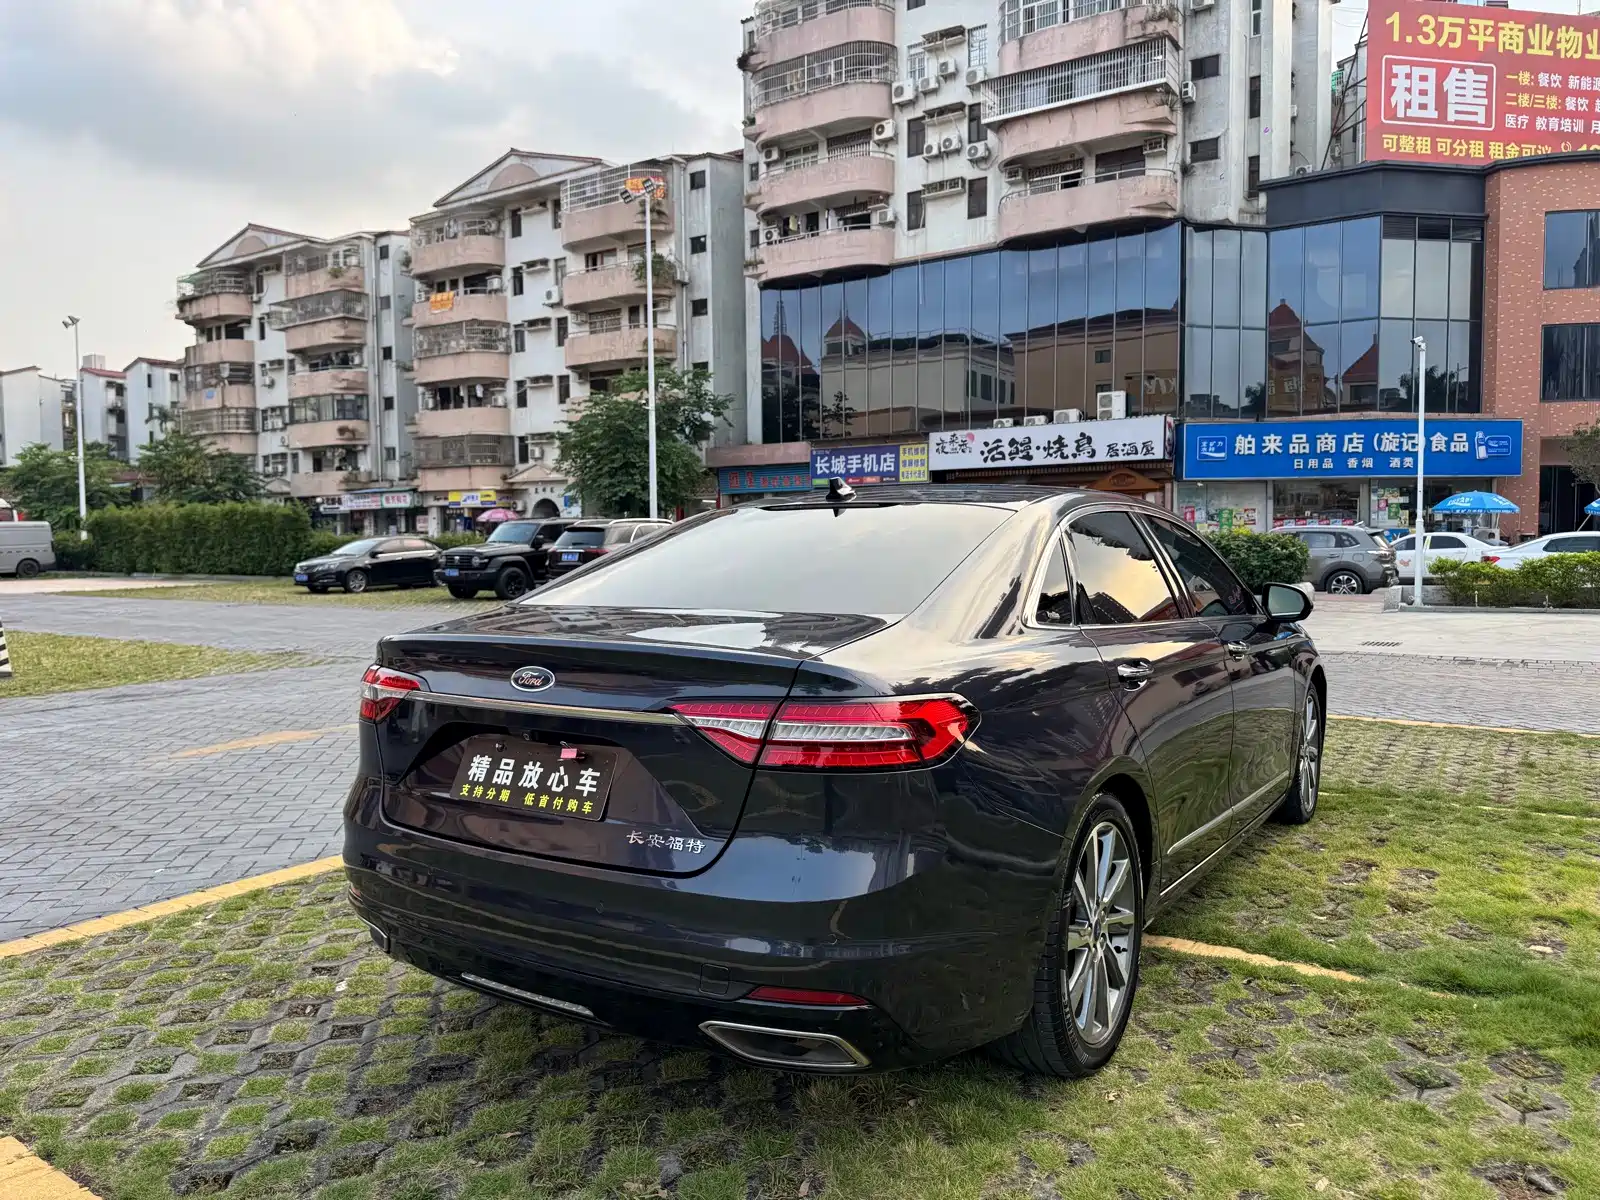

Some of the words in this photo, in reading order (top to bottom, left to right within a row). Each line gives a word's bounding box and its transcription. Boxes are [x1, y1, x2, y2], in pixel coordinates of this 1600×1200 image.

[1386, 12, 1600, 60] 1.3万平商业物业
[1506, 70, 1534, 86] 一楼:
[1538, 72, 1562, 88] 餐饮
[1391, 65, 1488, 124] 租售
[1506, 93, 1562, 110] 二楼/三楼:
[1565, 96, 1588, 112] 餐饮
[1505, 113, 1529, 129] 医疗
[1536, 116, 1584, 133] 教育培训
[1382, 134, 1431, 154] 可整租
[1436, 138, 1484, 158] 可分租
[1106, 441, 1155, 457] 居酒屋
[815, 453, 896, 475] 长城手机店
[1294, 458, 1333, 469] 日用品
[1347, 457, 1373, 468] 香烟
[1389, 457, 1414, 468] 酒类
[468, 754, 601, 797] 精品放心车
[460, 784, 511, 803] 支持分期
[523, 792, 594, 815] 低首付购车
[626, 830, 706, 854] 长安福特
